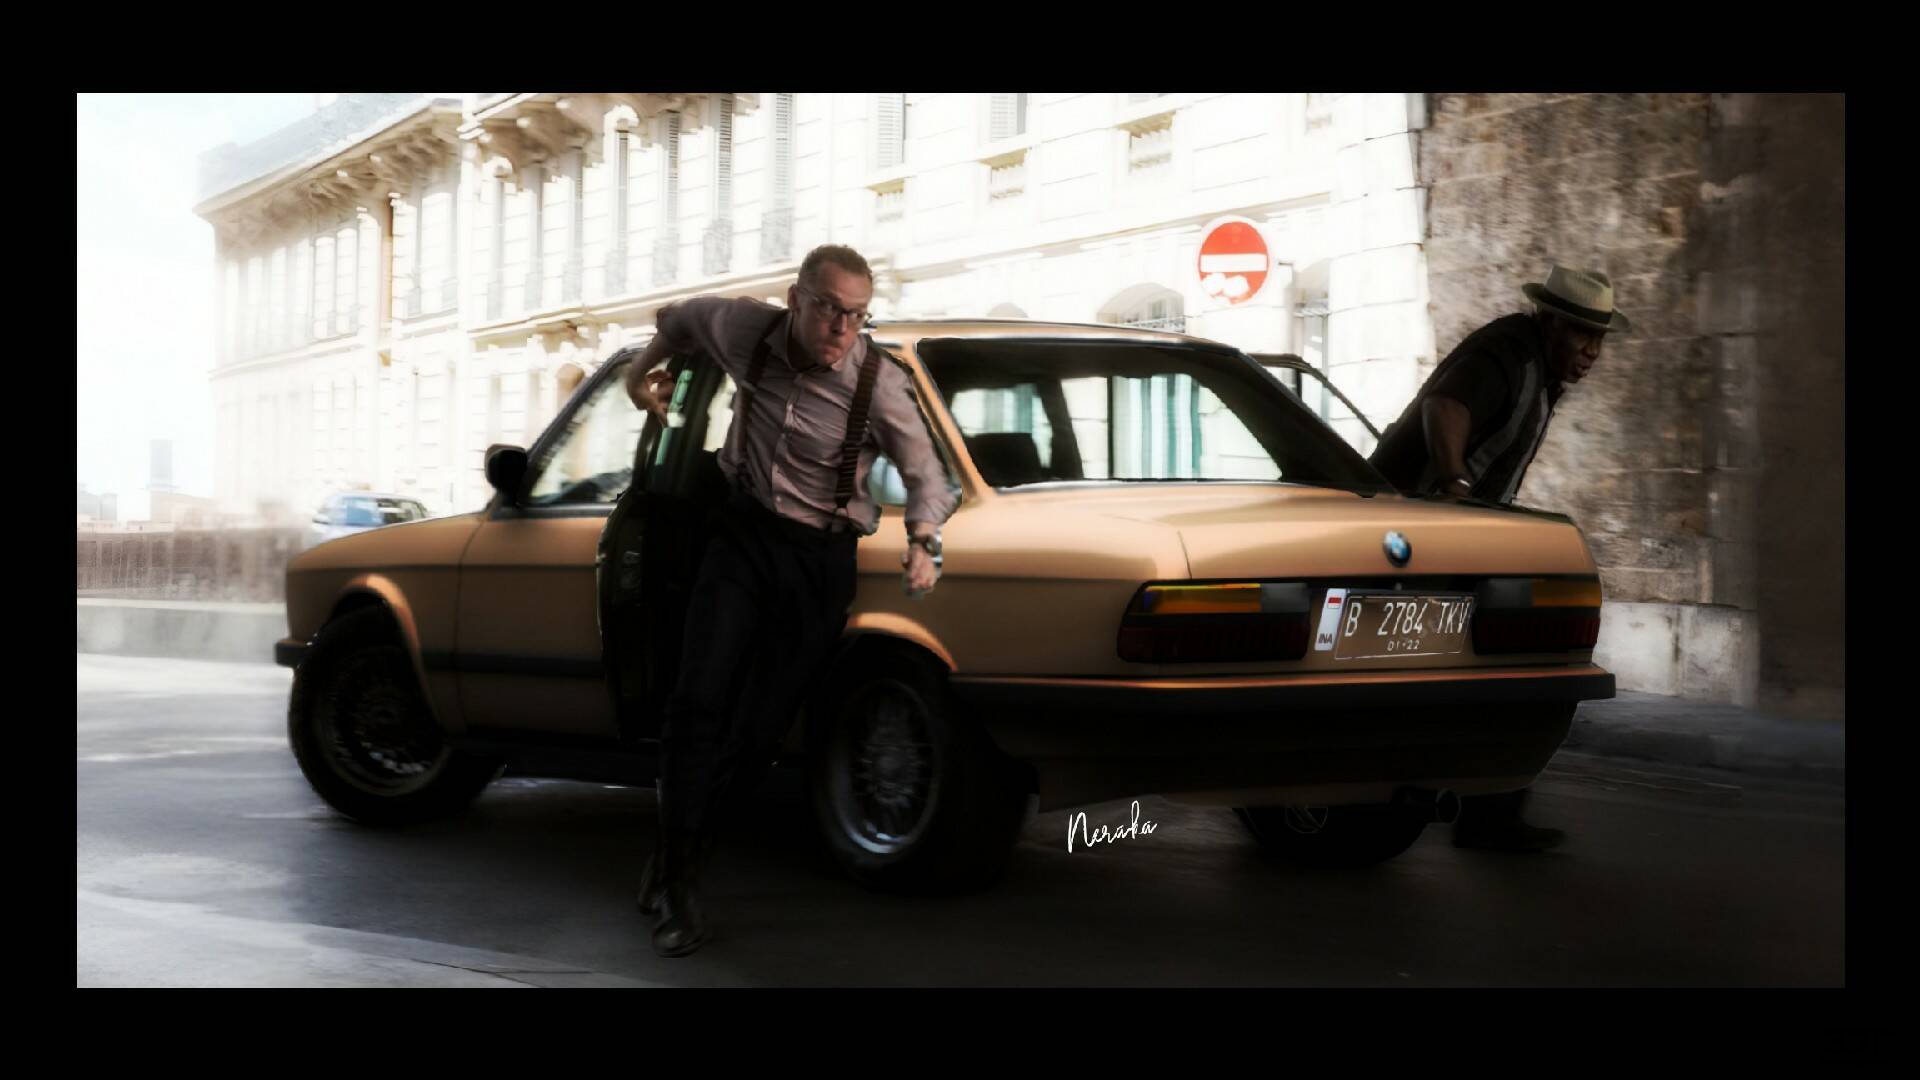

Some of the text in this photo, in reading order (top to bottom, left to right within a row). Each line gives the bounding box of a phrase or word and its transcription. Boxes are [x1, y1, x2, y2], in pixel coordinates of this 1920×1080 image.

[1344, 602, 1470, 637] B 2784 TKV
[1318, 633, 1333, 644] INA
